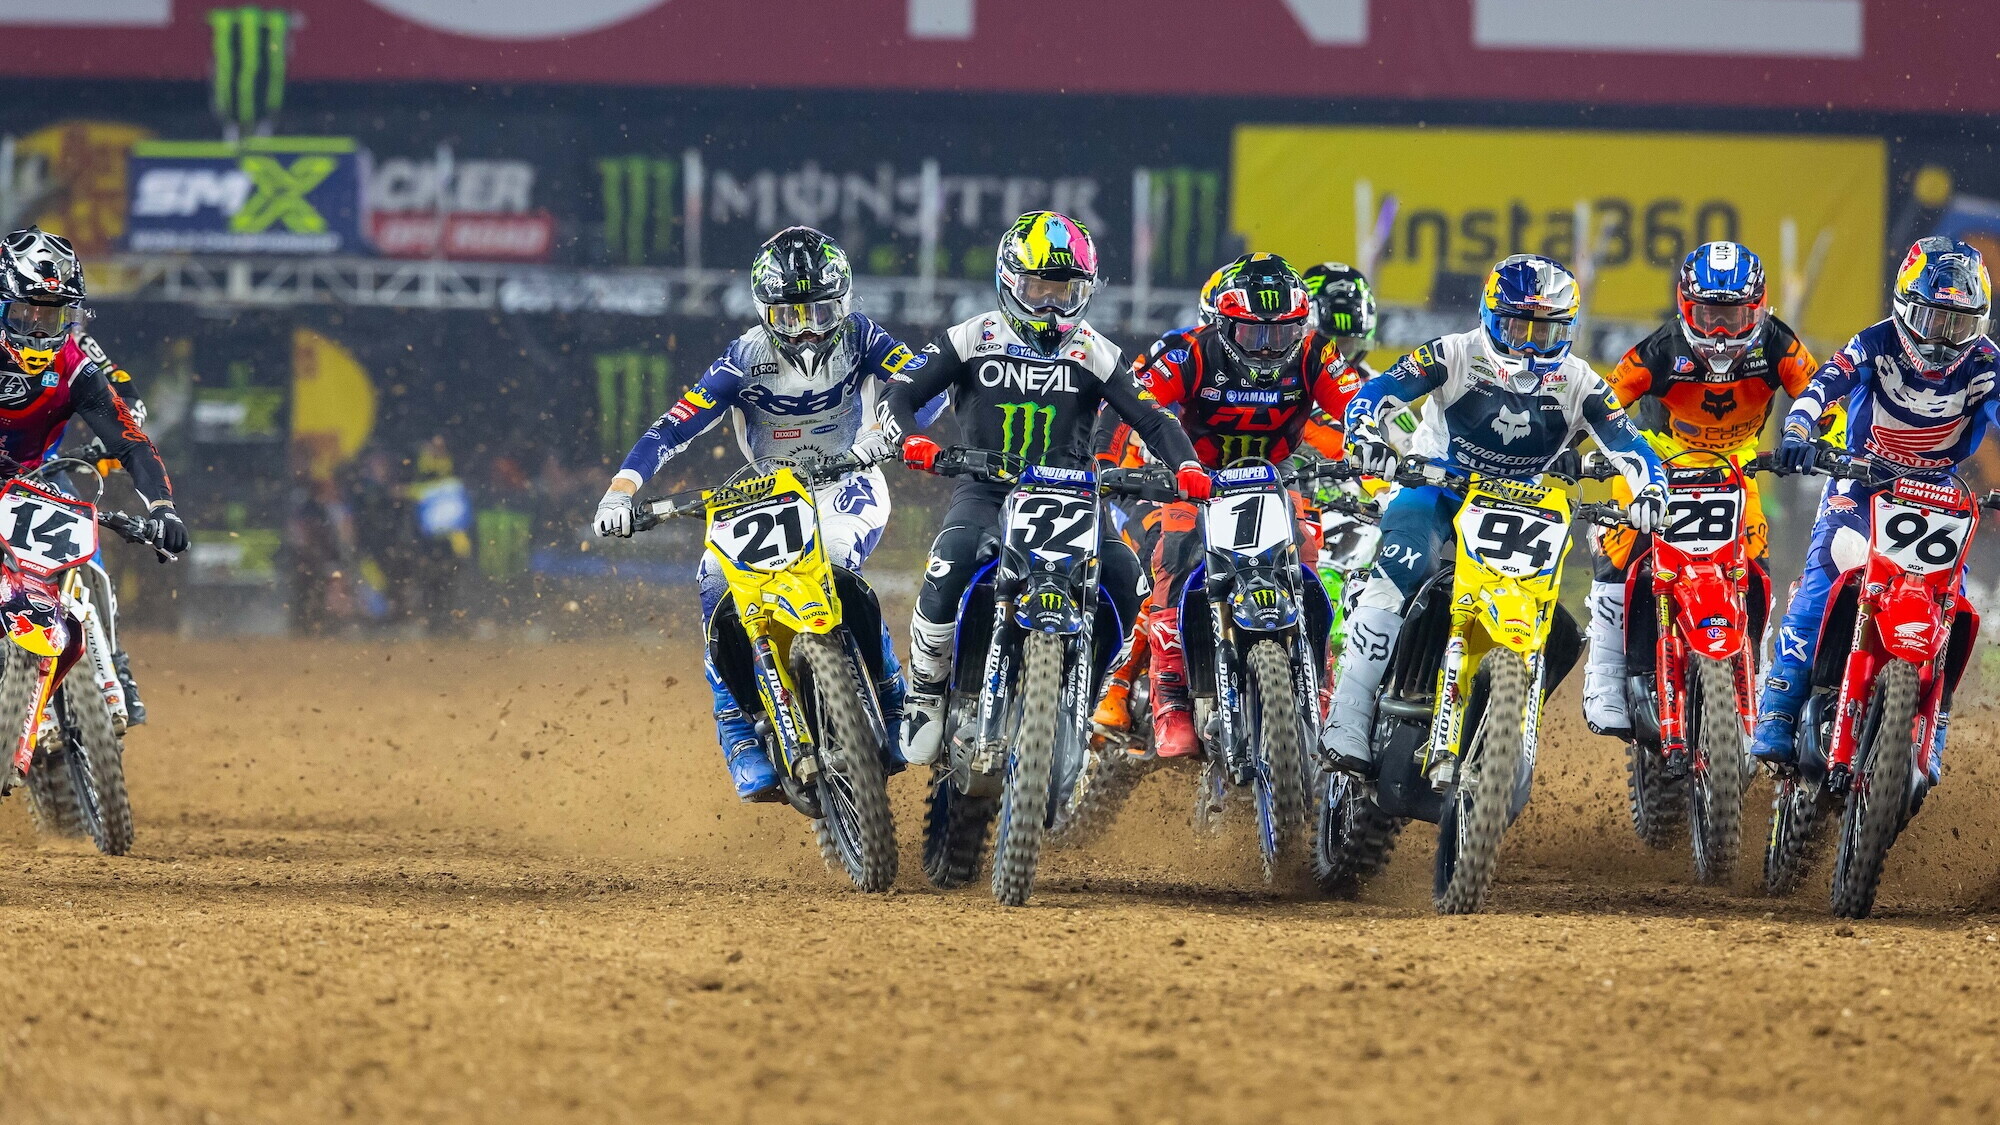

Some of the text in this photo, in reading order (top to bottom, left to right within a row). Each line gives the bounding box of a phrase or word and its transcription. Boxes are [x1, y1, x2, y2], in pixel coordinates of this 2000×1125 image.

[133, 156, 338, 234] SMX
[1750, 359, 1768, 370] RAIN
[1236, 391, 1278, 403] YAMAHA
[1207, 406, 1297, 431] FLY
[773, 430, 799, 438] DIXXON
[1452, 435, 1552, 466] PROGRESSIVE
[1864, 437, 1954, 468] HONDA
[1898, 486, 1956, 504] RENTHAL
[1900, 478, 1957, 495] RENTHAL
[6, 502, 81, 563] 14
[1012, 497, 1094, 555] 32
[1230, 495, 1264, 550] 1
[1598, 516, 1619, 525] ASV
[1663, 500, 1736, 543] 28
[733, 506, 803, 564] 21
[1475, 513, 1552, 568] 94
[1885, 512, 1958, 565] 96
[20, 560, 47, 574] DUCATI
[1505, 628, 1530, 637] DIXXON
[1893, 632, 1930, 644] HONDA
[1441, 667, 1457, 746] DUNLOP
[1328, 750, 1341, 762] FOX
